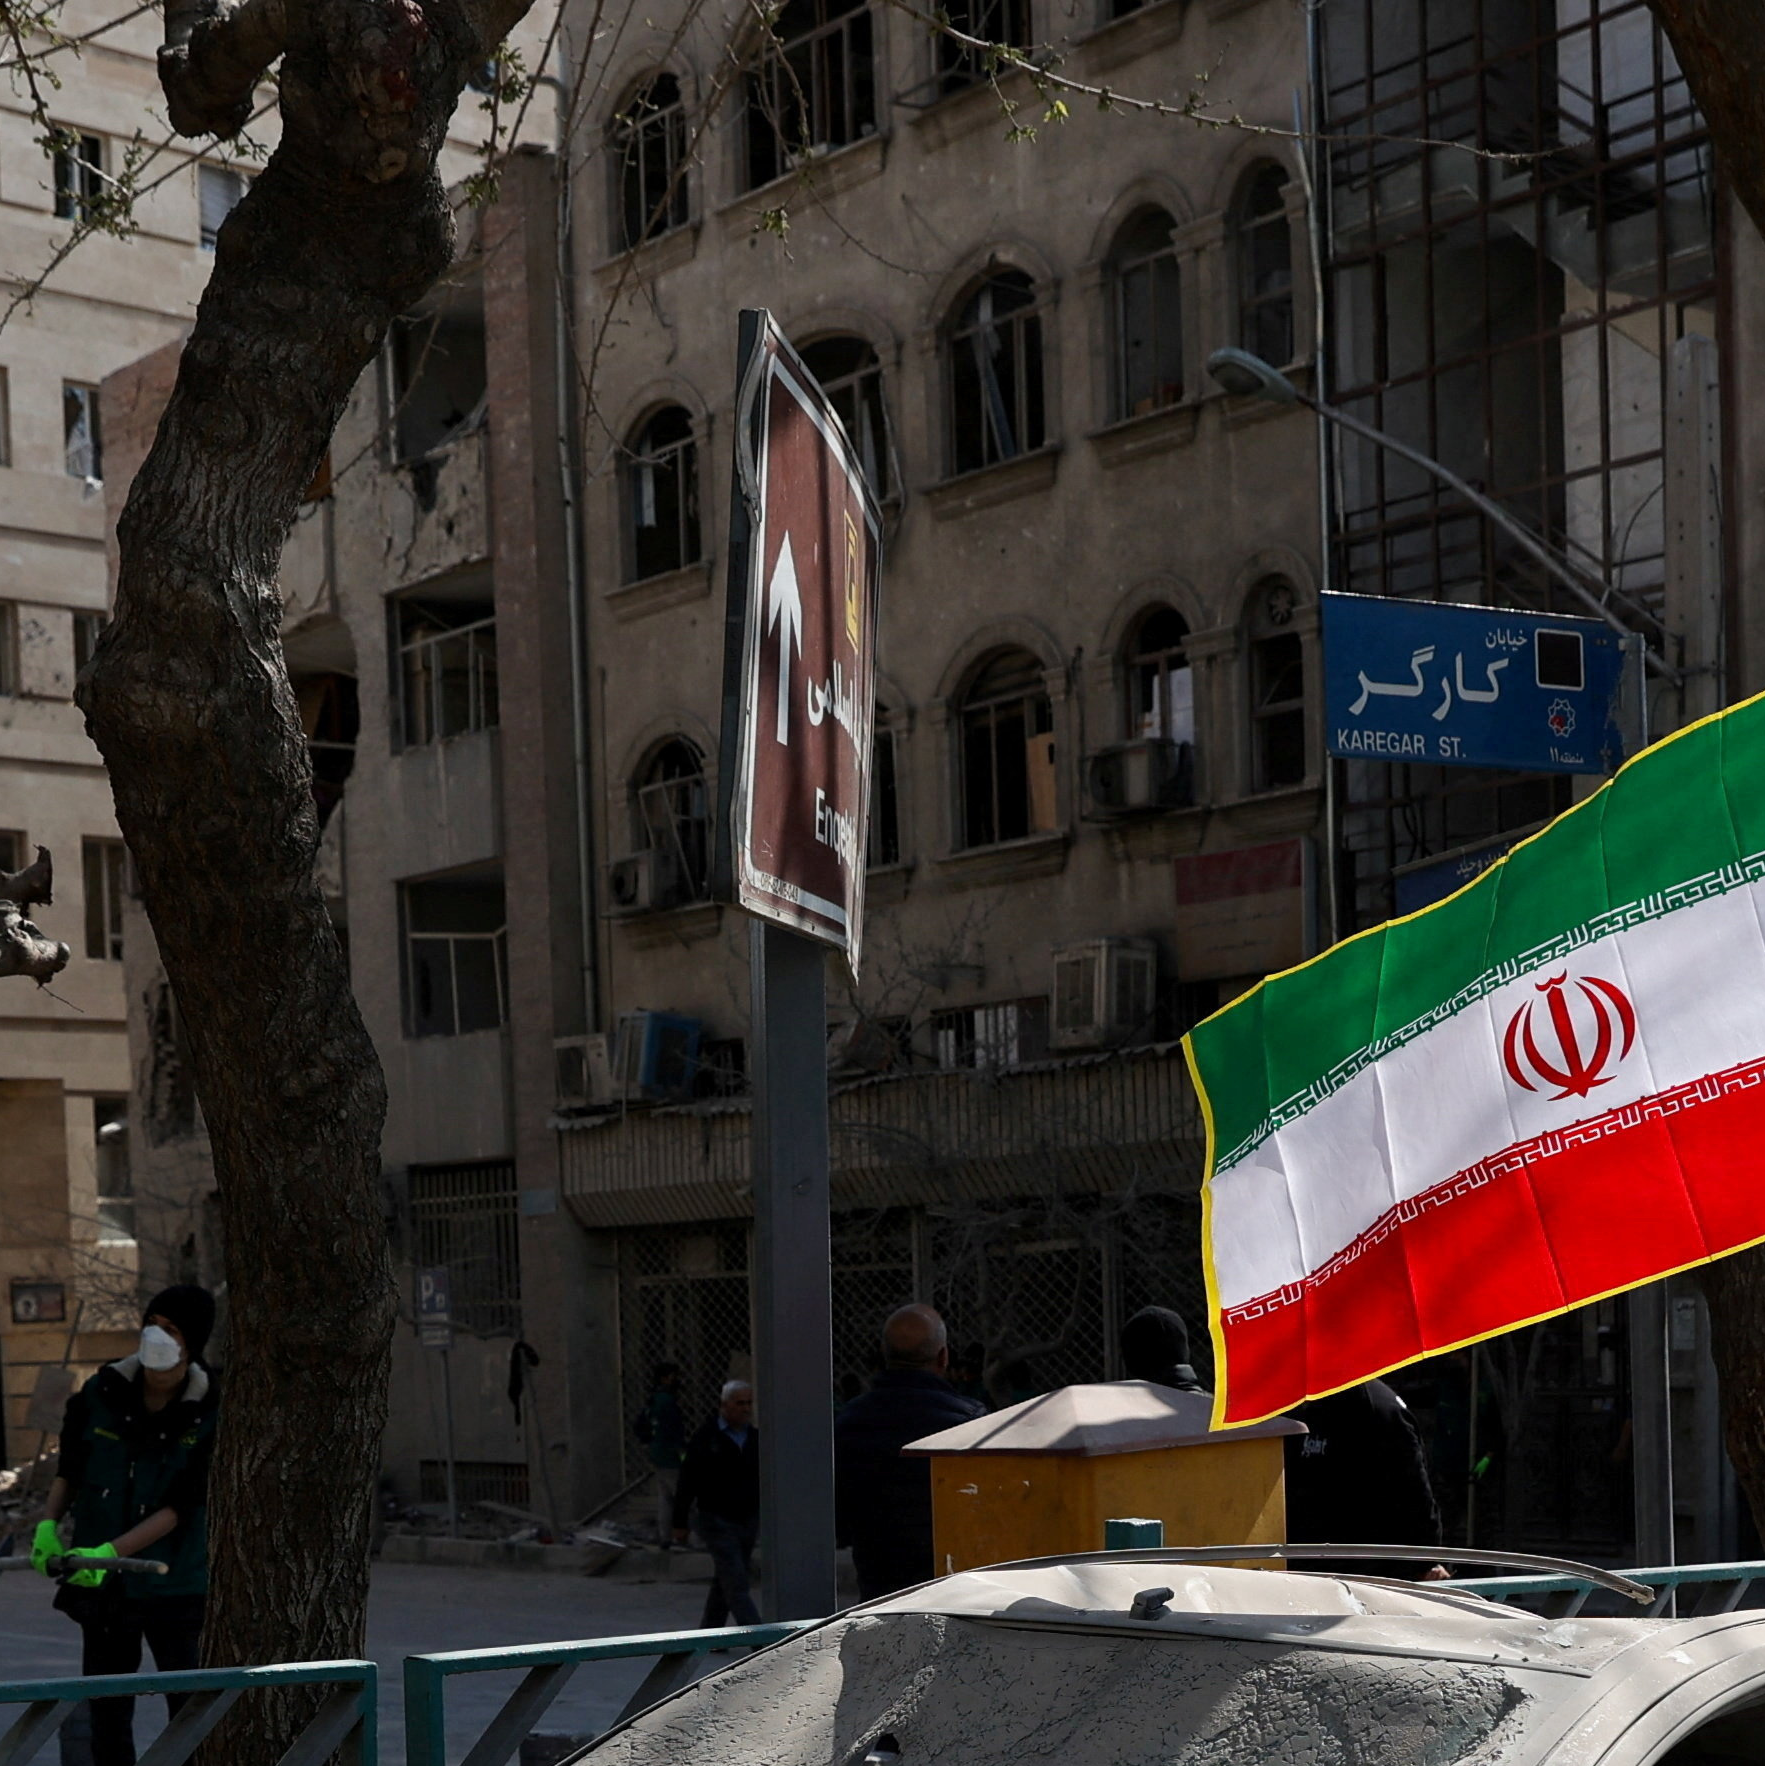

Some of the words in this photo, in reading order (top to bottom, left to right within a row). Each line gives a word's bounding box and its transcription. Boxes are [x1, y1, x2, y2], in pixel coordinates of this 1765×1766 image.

[1485, 628, 1528, 652] خیابان
[1347, 644, 1510, 722] کارگر
[1337, 728, 1426, 757] KAREGAR
[1438, 736, 1467, 758] ST.
